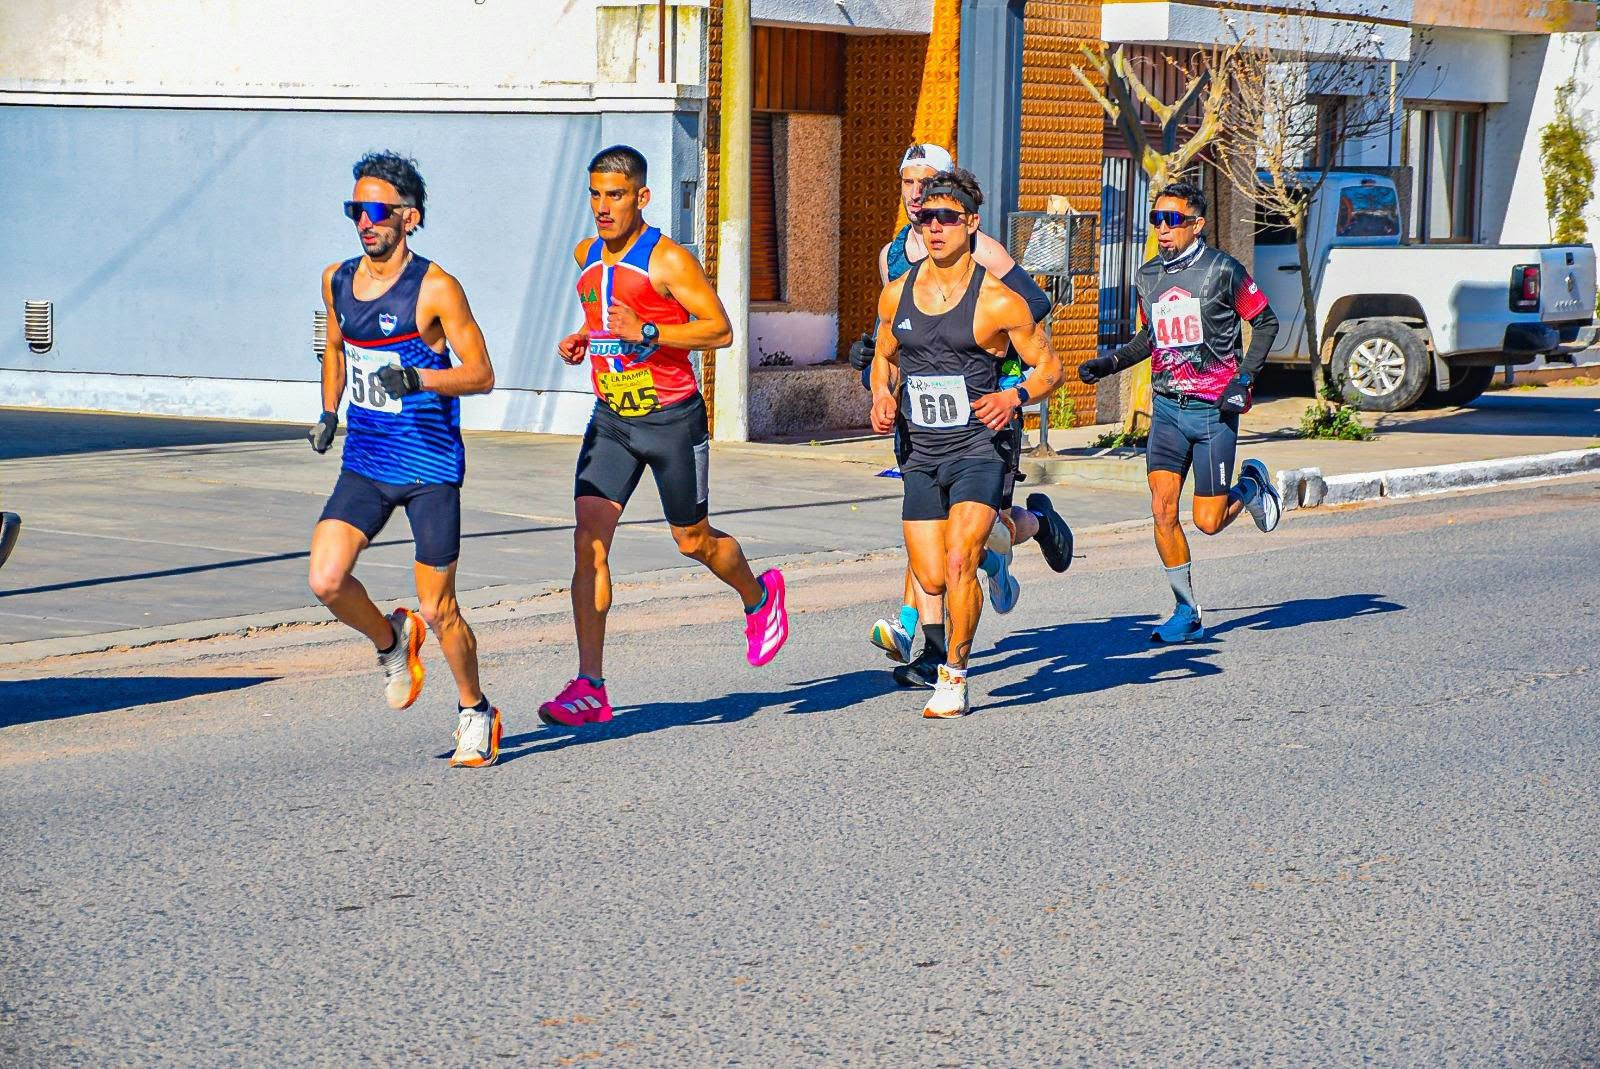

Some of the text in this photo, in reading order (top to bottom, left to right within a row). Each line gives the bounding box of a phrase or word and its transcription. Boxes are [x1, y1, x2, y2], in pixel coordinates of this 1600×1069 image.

[1157, 315, 1200, 345] 446
[352, 365, 386, 408] 58
[611, 369, 649, 383] LA PAMPA
[920, 393, 958, 425] 60
